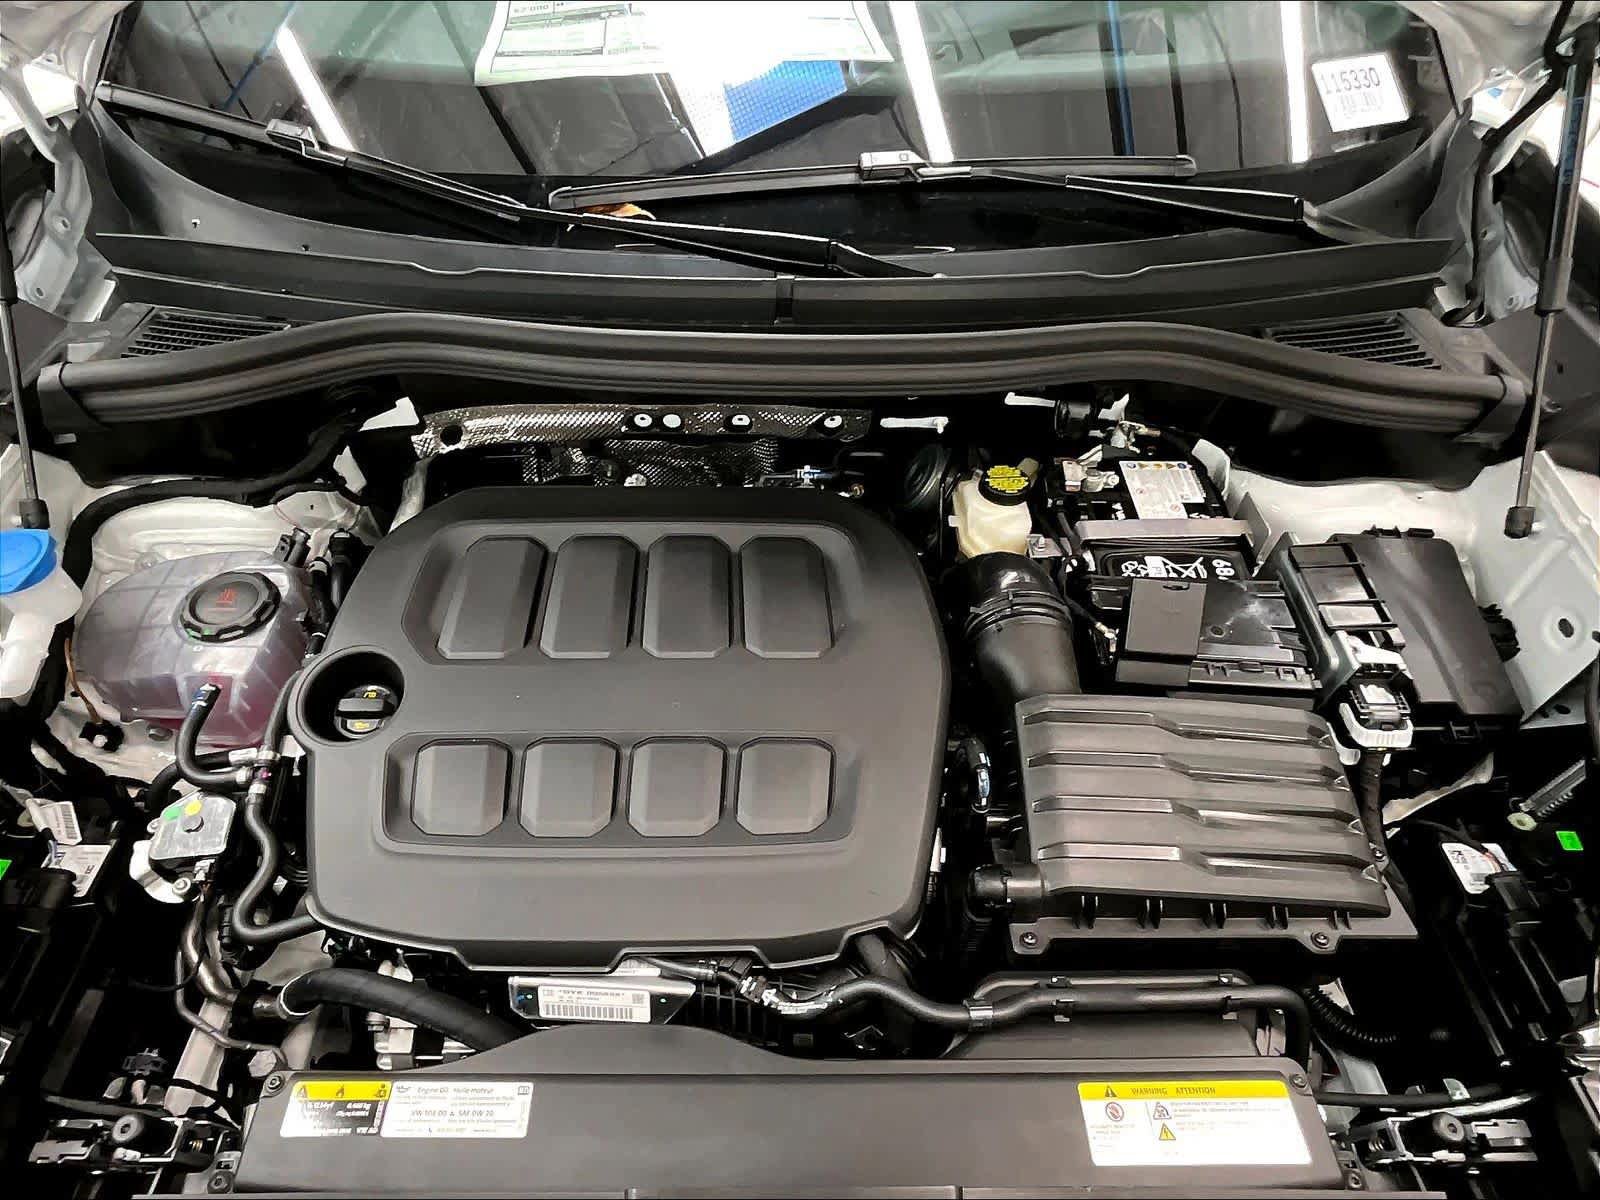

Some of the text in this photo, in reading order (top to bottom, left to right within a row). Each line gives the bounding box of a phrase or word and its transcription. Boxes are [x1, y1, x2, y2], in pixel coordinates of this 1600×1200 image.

[1320, 67, 1381, 94] 115330
[1131, 1087, 1216, 1096] WARNING ATTENTION
